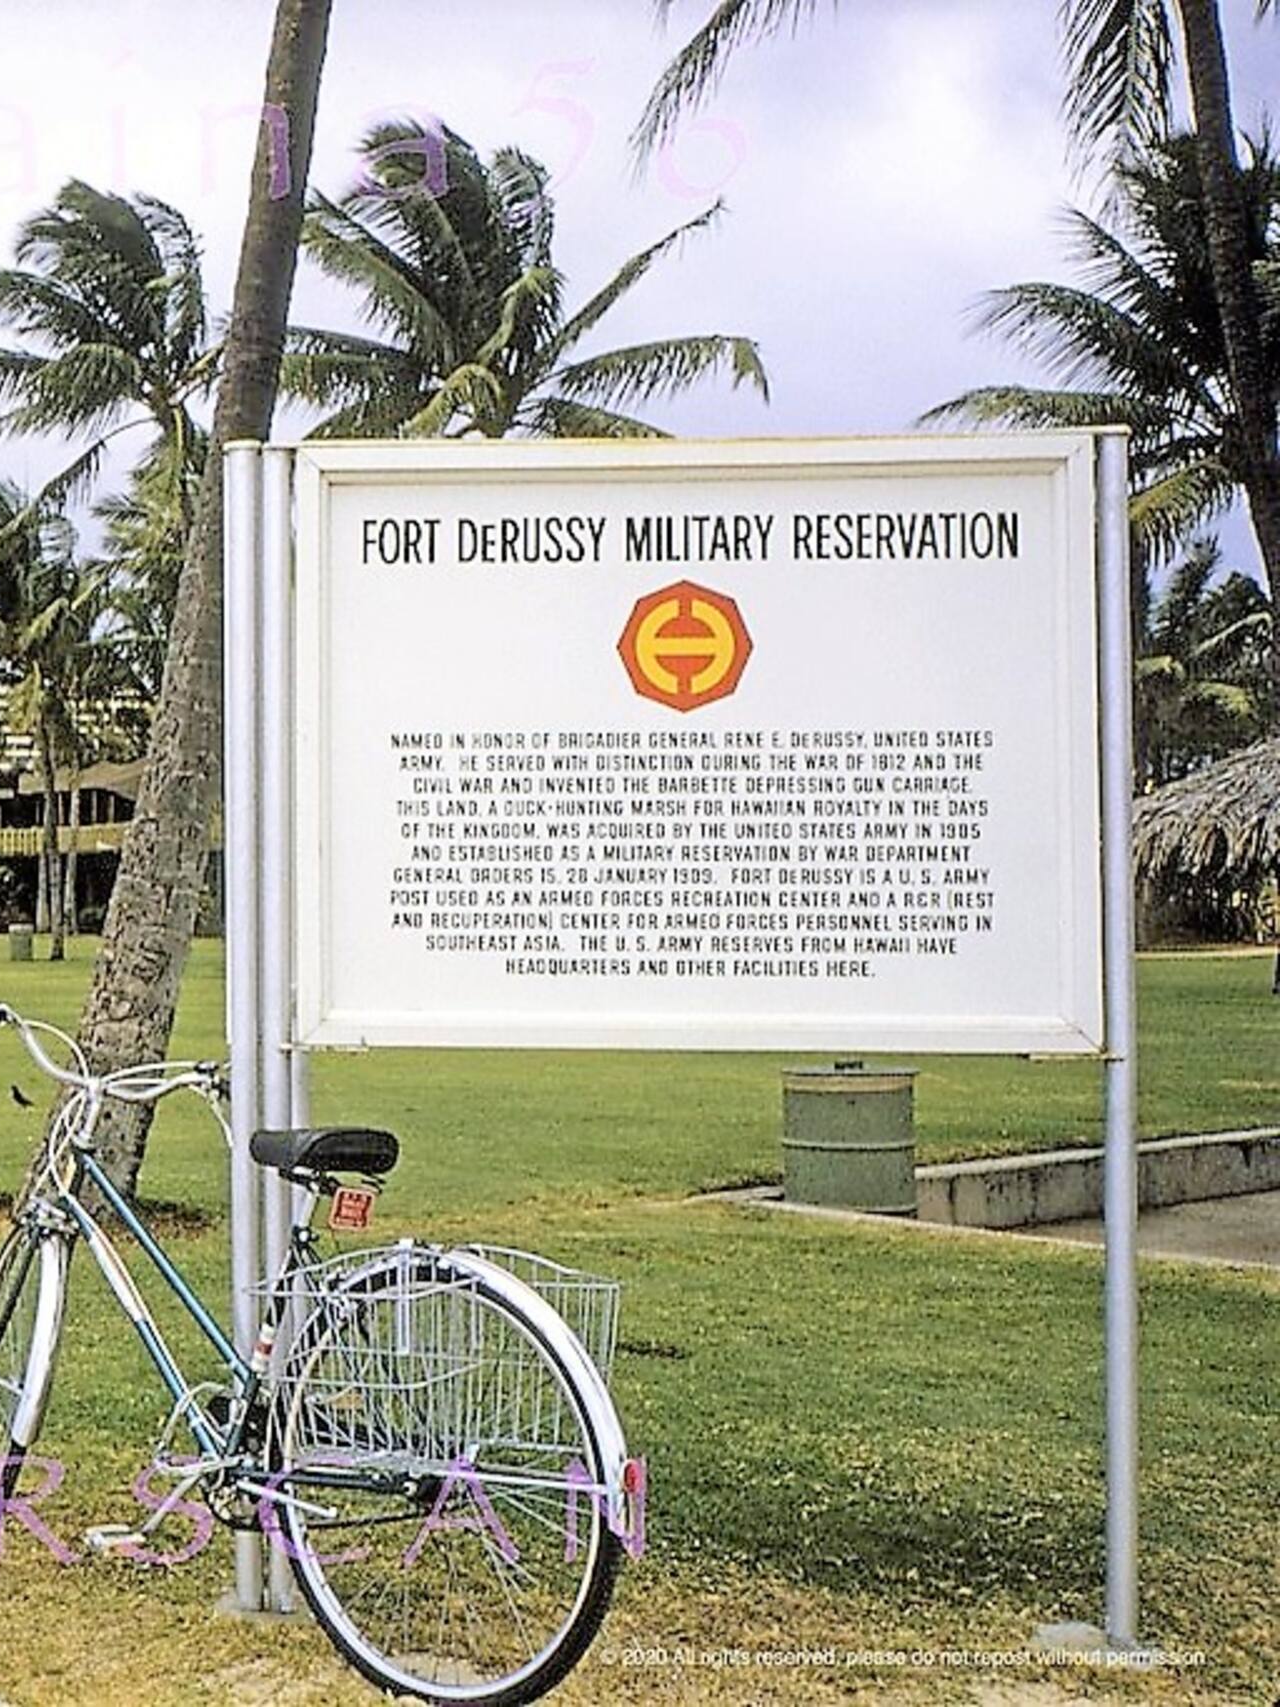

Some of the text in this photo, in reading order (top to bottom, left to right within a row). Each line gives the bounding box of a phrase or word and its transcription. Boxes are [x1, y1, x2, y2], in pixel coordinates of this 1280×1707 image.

[363, 518, 442, 565] FORT
[625, 514, 775, 562] MILITARY
[793, 511, 1018, 560] RESERVATION
[391, 733, 442, 749] NAMED
[450, 733, 465, 749] IN
[472, 733, 525, 749] HONOR
[531, 732, 550, 749] OF
[559, 732, 641, 749] BRIGADIER
[649, 731, 717, 749] GENERAL
[724, 731, 764, 749] RENE
[873, 731, 928, 748] UNITED
[936, 730, 993, 749] STATES
[459, 755, 478, 772] HE
[486, 755, 545, 772] SERVED
[552, 755, 588, 771] WITH
[596, 754, 694, 772] DISTINCTION
[701, 753, 761, 771] DURING
[769, 753, 797, 772] THE
[804, 754, 838, 771] WAR
[846, 753, 864, 771] OF
[871, 753, 906, 772] 1812
[912, 752, 946, 771] AND
[952, 753, 983, 771] THE
[413, 777, 453, 794] CIVIL
[459, 777, 493, 794] WAR
[500, 777, 532, 794] AND
[539, 776, 615, 794] INVENTED
[622, 776, 650, 794] THE
[658, 776, 737, 794] BARBETTE
[745, 776, 846, 794] DEPRESSING
[852, 776, 885, 794] GUN
[396, 800, 430, 817] THIS
[488, 800, 498, 816] A
[631, 800, 687, 817] MARSH
[694, 799, 724, 817] FOR
[731, 800, 805, 817] HAWAIIAN
[813, 799, 882, 817] ROYALTY
[889, 800, 905, 817] IN
[912, 799, 941, 817] THE
[948, 799, 988, 817] DAYS
[401, 823, 420, 839] OF
[427, 823, 455, 839] THE
[546, 822, 580, 839] WAS
[586, 822, 665, 840] ACQUIRED
[672, 822, 693, 839] BY
[699, 822, 727, 839] THE
[734, 822, 792, 840] UNITED
[799, 822, 856, 840] STATES
[863, 822, 909, 840] ARMY
[915, 822, 932, 839] IN
[939, 822, 981, 840] 1905
[411, 844, 971, 863] AND ESTABLISHED AS A MILITARY RESERVATION BY WAR DEPARTMENT
[393, 867, 463, 884] GENERAL
[470, 867, 533, 884] ORDERS
[593, 867, 668, 885] JANUARY
[730, 867, 772, 885] FORT
[859, 868, 876, 885] IS
[881, 868, 893, 885] A
[942, 868, 990, 885] ARMY
[390, 890, 429, 906] POST
[436, 890, 479, 907] USED
[485, 890, 505, 907] AS
[511, 890, 532, 907] AN
[538, 890, 594, 907] ARMED
[601, 890, 663, 907] FORCES
[671, 890, 771, 908] RECREATION
[779, 890, 841, 909] CENTER
[847, 891, 880, 909] AND
[886, 891, 897, 909] A
[391, 912, 423, 929] AND
[560, 912, 620, 930] CENTER
[627, 913, 659, 930] FOR
[664, 912, 720, 930] ARMED
[726, 913, 788, 931] FORCES
[796, 913, 892, 932] PERSONNEL
[898, 914, 968, 932] SERVING
[976, 915, 992, 932] IN
[426, 934, 517, 952] SOUTHEAST
[523, 935, 565, 952] ASIA.
[579, 935, 607, 952] THE
[656, 935, 703, 953] ARMY
[711, 935, 794, 954] RESERVES
[801, 936, 846, 954] FROM
[854, 936, 910, 954] HAWAII
[917, 937, 957, 955] HAVE
[506, 958, 875, 977] HEADQUARTERS AND OTHER FACILITIES HERE.
